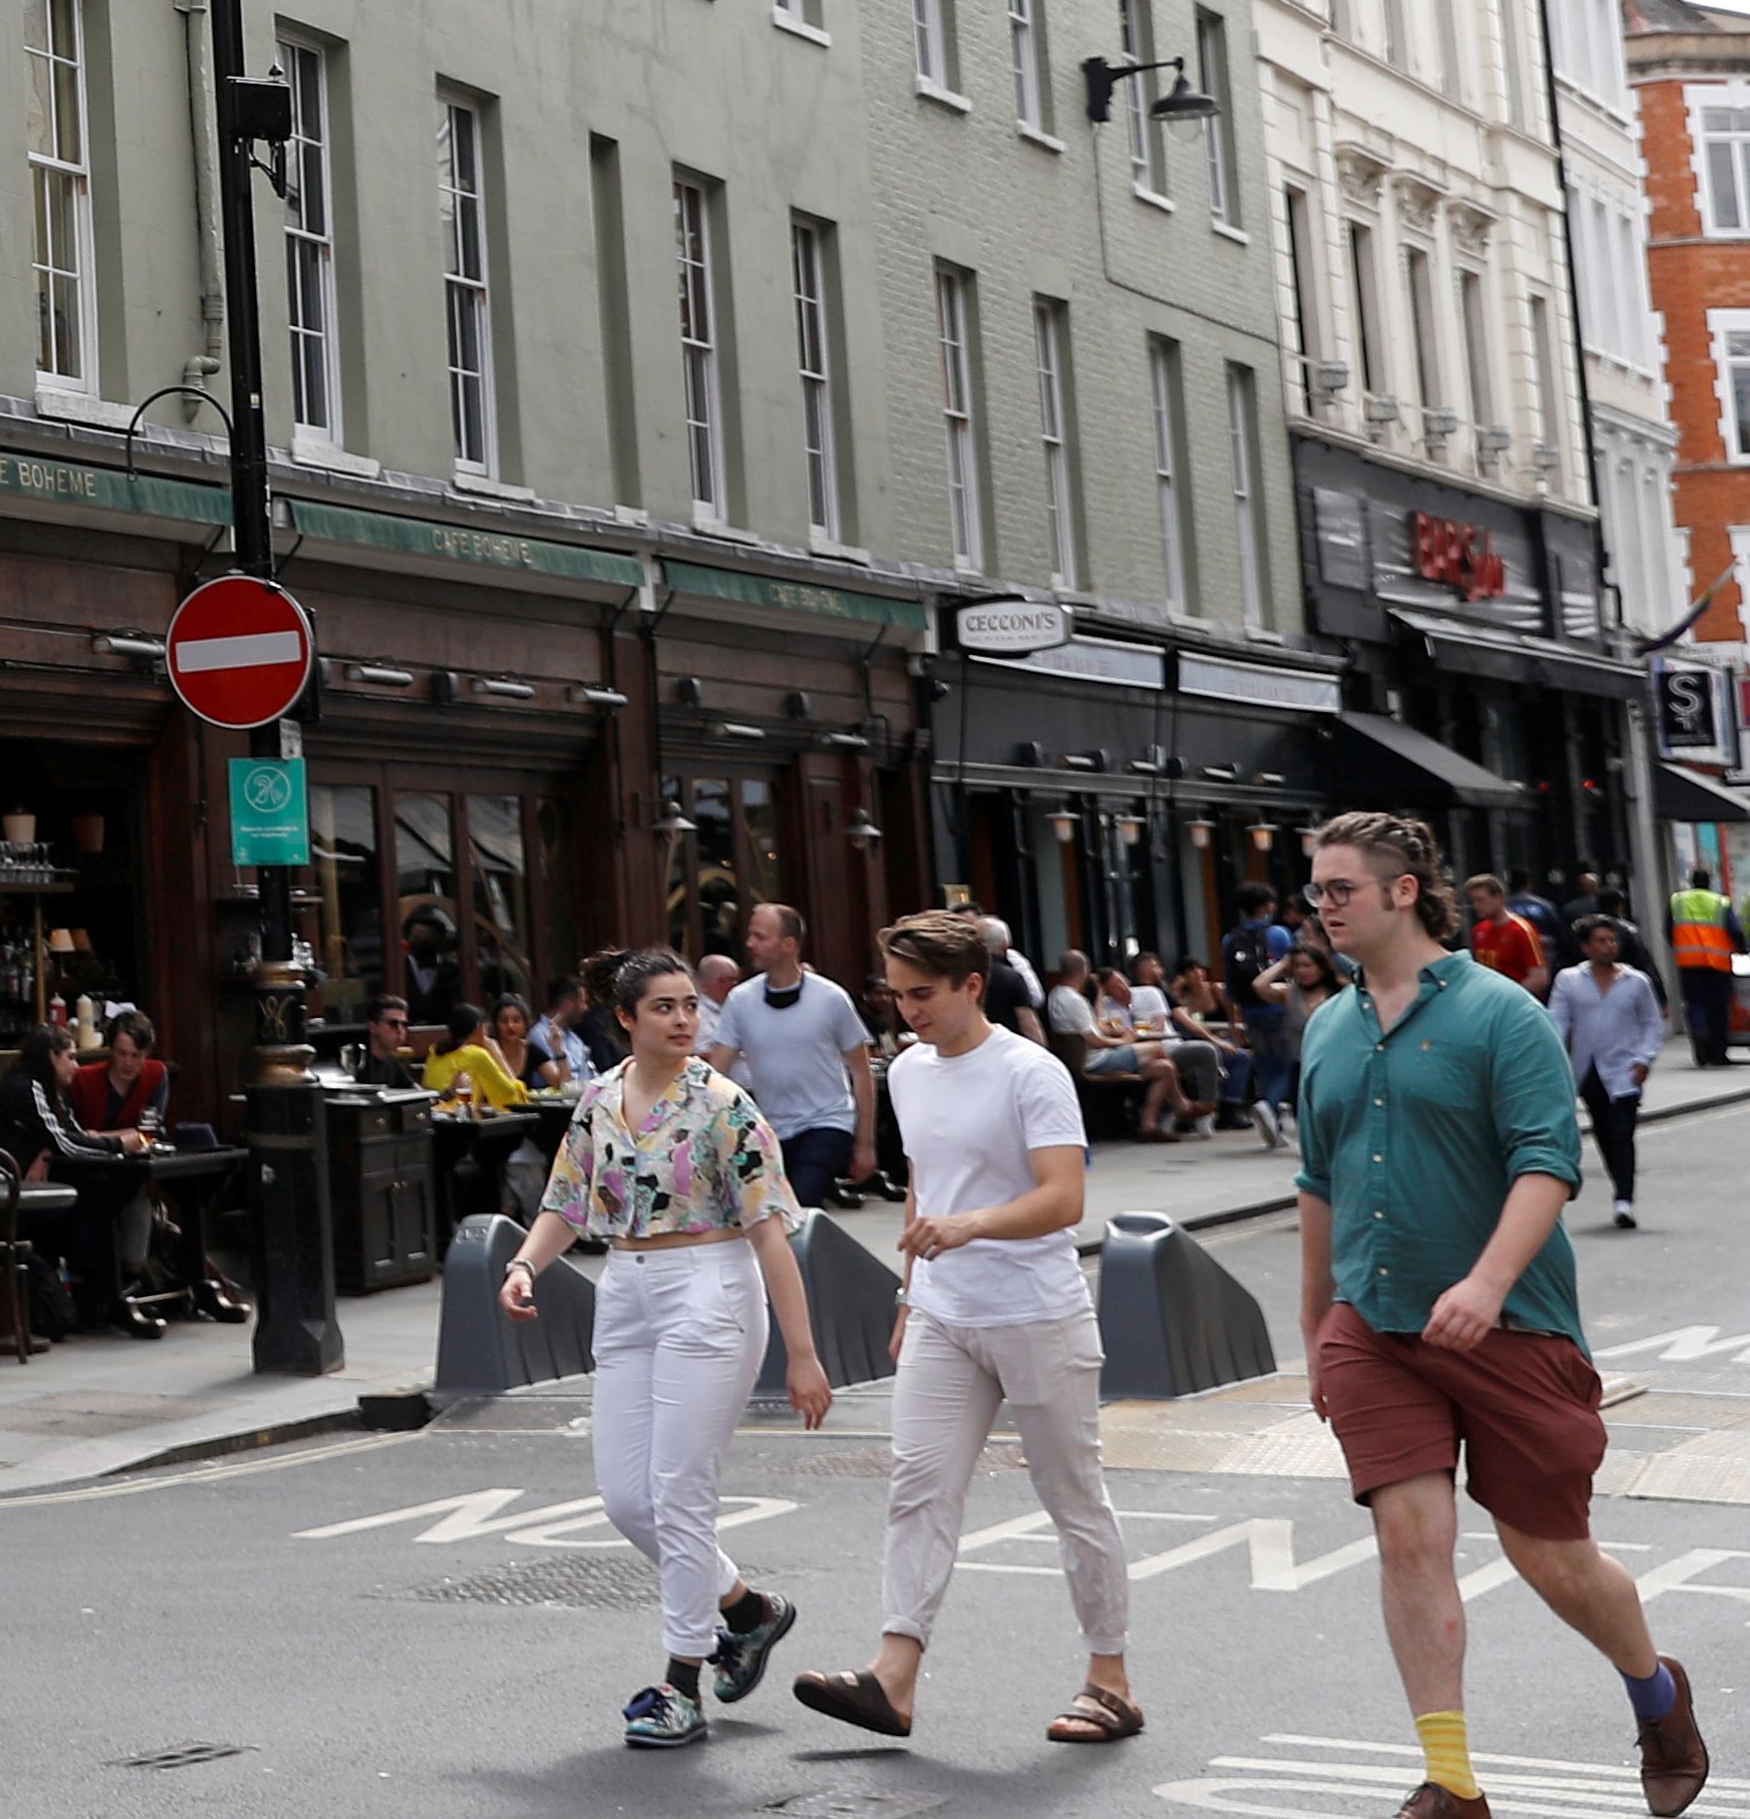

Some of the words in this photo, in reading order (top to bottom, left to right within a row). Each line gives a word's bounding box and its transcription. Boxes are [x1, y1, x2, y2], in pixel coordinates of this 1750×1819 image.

[17, 460, 97, 497] BOHEME
[433, 528, 469, 553] CAFE
[965, 612, 1056, 632] CECCONI'S
